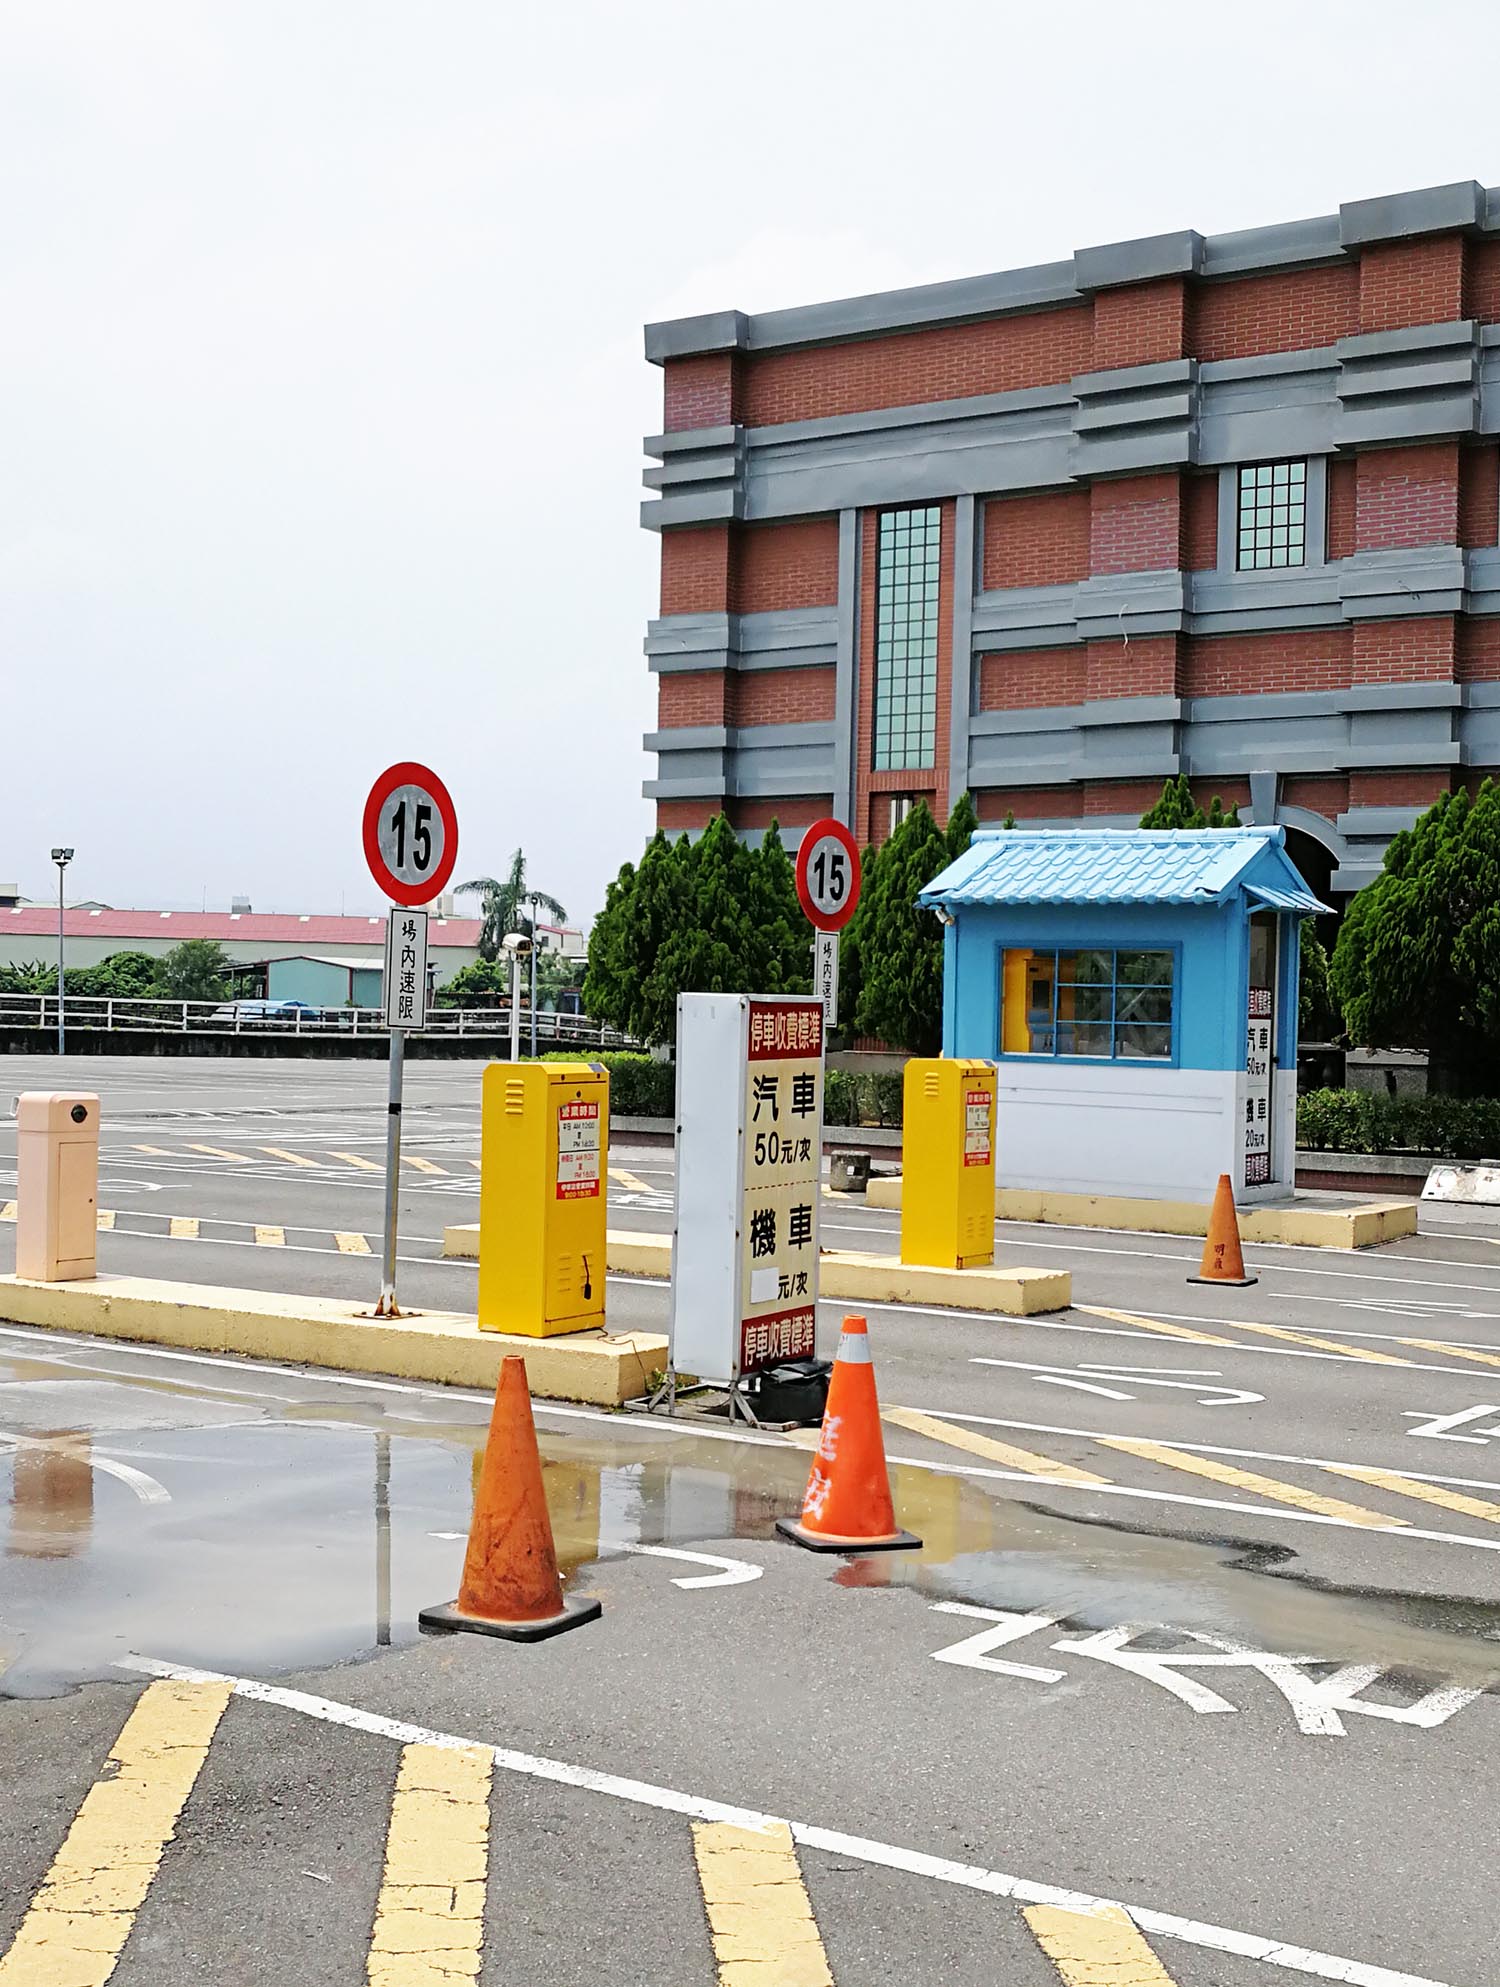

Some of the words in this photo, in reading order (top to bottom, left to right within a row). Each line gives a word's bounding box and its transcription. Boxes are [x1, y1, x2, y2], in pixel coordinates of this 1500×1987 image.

[391, 800, 432, 872] 15
[813, 851, 845, 901] 15
[398, 918, 418, 1021] 場內速限
[750, 1011, 821, 1052] 停車收費標準
[752, 1071, 816, 1122] 汽車
[754, 1130, 812, 1167] 50元/次
[749, 1203, 813, 1259] 機車
[744, 1313, 814, 1367] 停車收費標準
